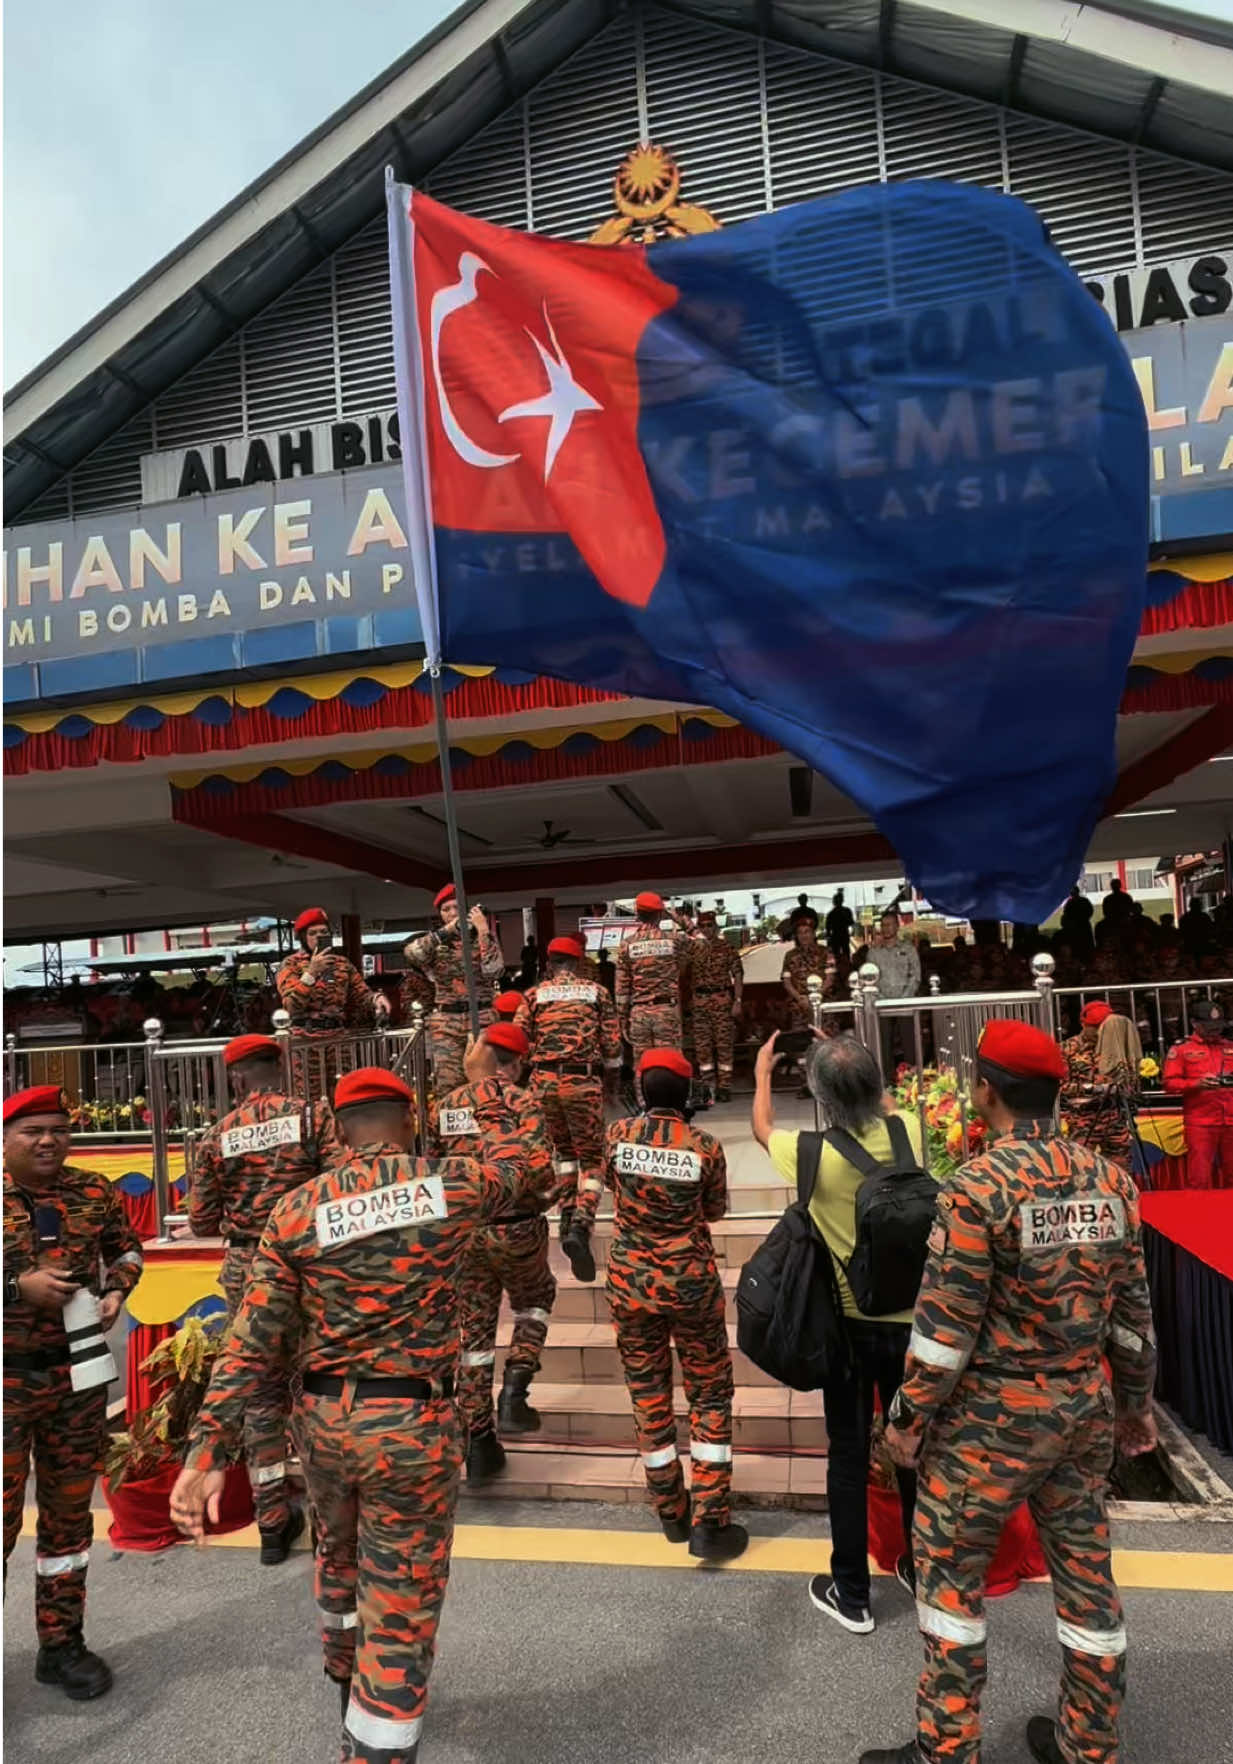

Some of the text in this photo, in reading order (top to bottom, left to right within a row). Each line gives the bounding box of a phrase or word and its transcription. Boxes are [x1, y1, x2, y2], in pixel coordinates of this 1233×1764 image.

[177, 430, 314, 498] ALAH
[79, 590, 231, 638] BOMBA
[260, 570, 351, 610] DAN
[741, 466, 1053, 537] MAAYSIA
[218, 500, 314, 575] KE
[228, 1120, 292, 1144] BOMBA
[622, 1147, 693, 1168] BOMBA
[622, 1161, 692, 1178] MALAYSIA
[326, 1183, 433, 1225] BOMBA
[1031, 1202, 1117, 1228] BOMBA
[329, 1204, 434, 1240] MALAYSIA
[1032, 1224, 1117, 1245] MALAYSIA
